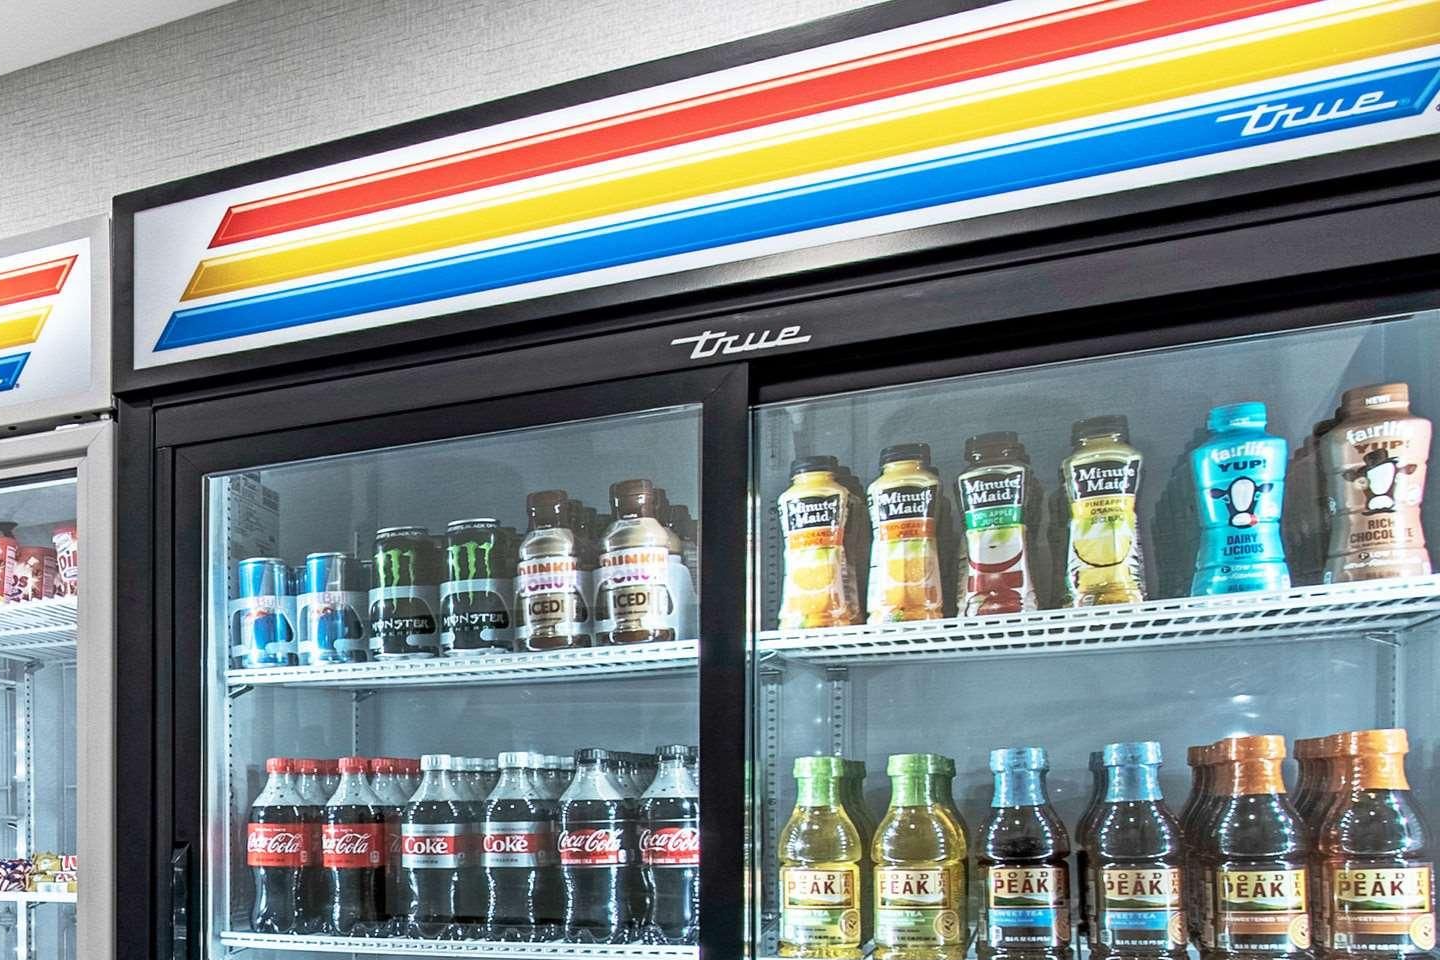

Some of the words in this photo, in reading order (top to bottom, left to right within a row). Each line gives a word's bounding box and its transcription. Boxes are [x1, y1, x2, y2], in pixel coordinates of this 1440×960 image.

[1346, 422, 1413, 444] fairlif
[1211, 442, 1274, 462] fairlif
[1218, 459, 1267, 472] YUP!
[1080, 467, 1135, 481] Minute
[966, 477, 1021, 493] Minute
[1087, 480, 1129, 492] Maid
[879, 490, 932, 504] Minute
[972, 491, 1011, 505] Maid
[789, 499, 837, 513] Minute
[889, 504, 925, 516] Maid
[796, 512, 830, 526] Maid
[1226, 534, 1257, 546] DAIRY
[1350, 527, 1414, 544] CHOCOLE
[1223, 544, 1264, 557] LICIOUS
[614, 593, 646, 608] ICED
[373, 618, 430, 629] MONSTER
[443, 611, 504, 628] MONSTER
[404, 837, 449, 854] Coke
[483, 835, 528, 852] Coke
[557, 828, 623, 852] Coca-Cola
[994, 879, 1049, 894] PEAK
[1106, 880, 1163, 895] PEAK
[1222, 881, 1285, 898] PEAK
[1338, 881, 1404, 897] PEAK
